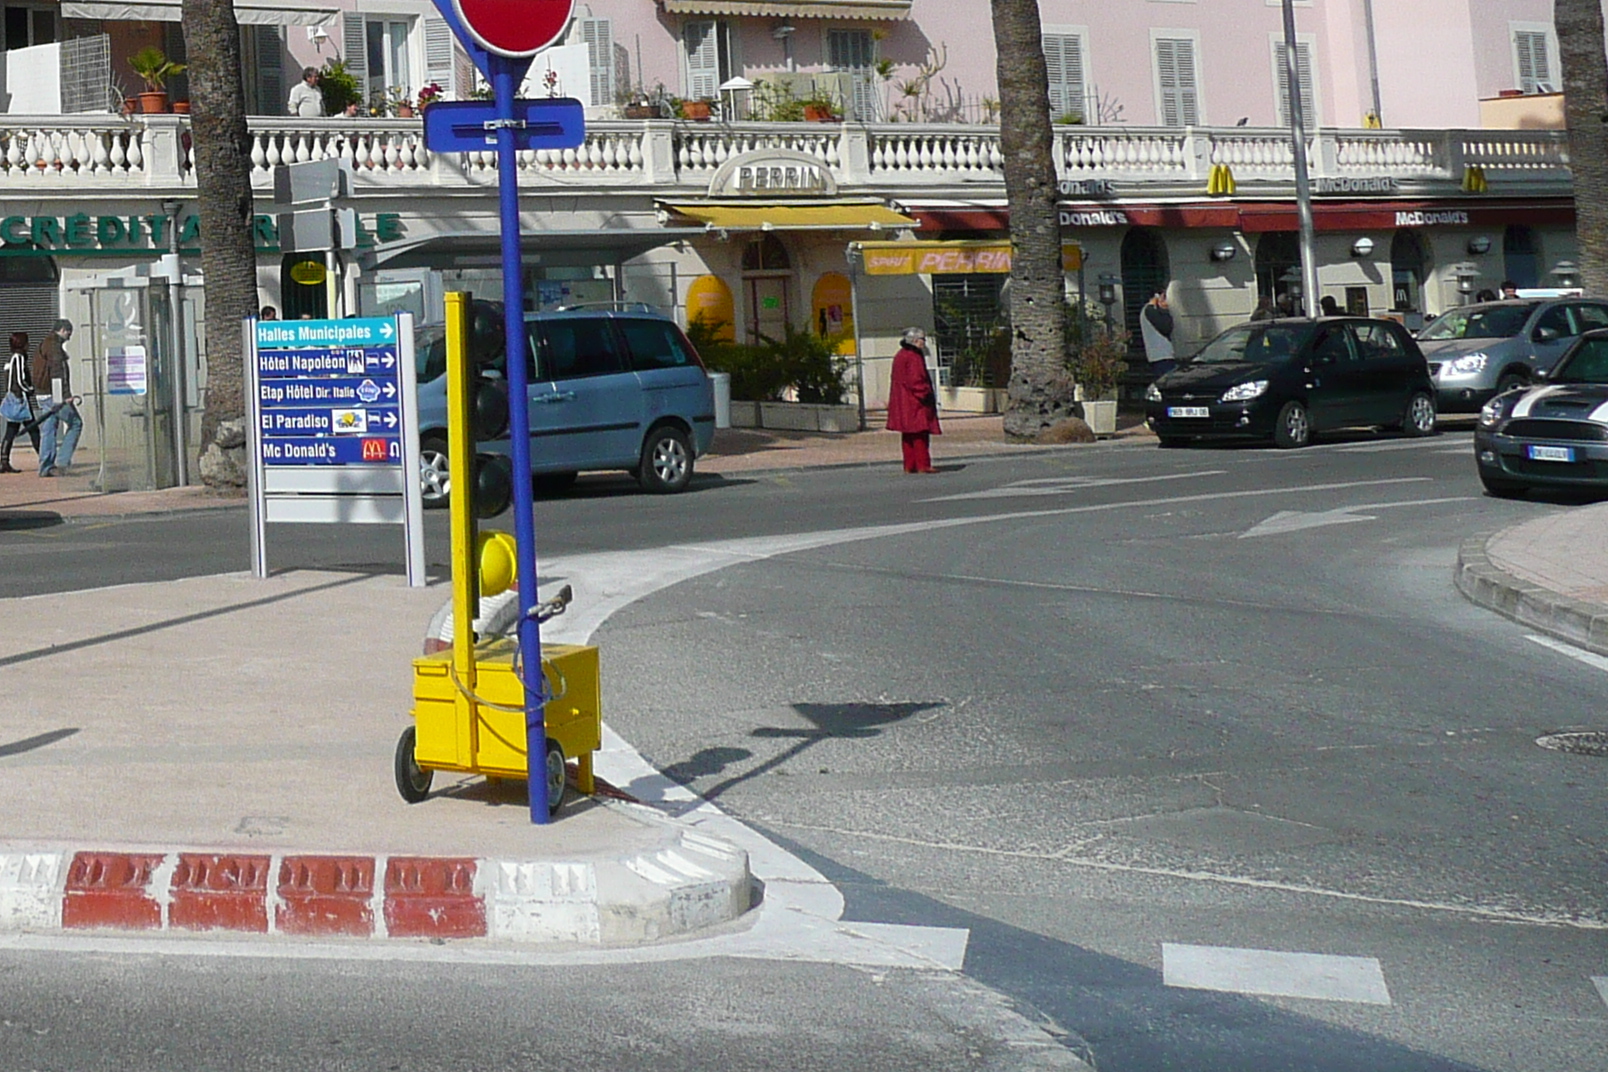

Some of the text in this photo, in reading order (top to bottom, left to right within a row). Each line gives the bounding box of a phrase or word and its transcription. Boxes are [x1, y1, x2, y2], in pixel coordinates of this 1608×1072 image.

[735, 167, 826, 189] PERRIN
[1316, 177, 1399, 192] McDonald's
[1395, 211, 1469, 226] McDonald's
[258, 325, 371, 343] Halles Municipales
[260, 355, 345, 372] Hôtel Napoléon
[261, 386, 283, 402] Etap
[286, 384, 313, 399] Hôtel
[333, 387, 355, 398] Italie
[262, 415, 273, 428] El
[277, 414, 329, 428] Paradiso
[263, 443, 336, 458] Mc Donald's
